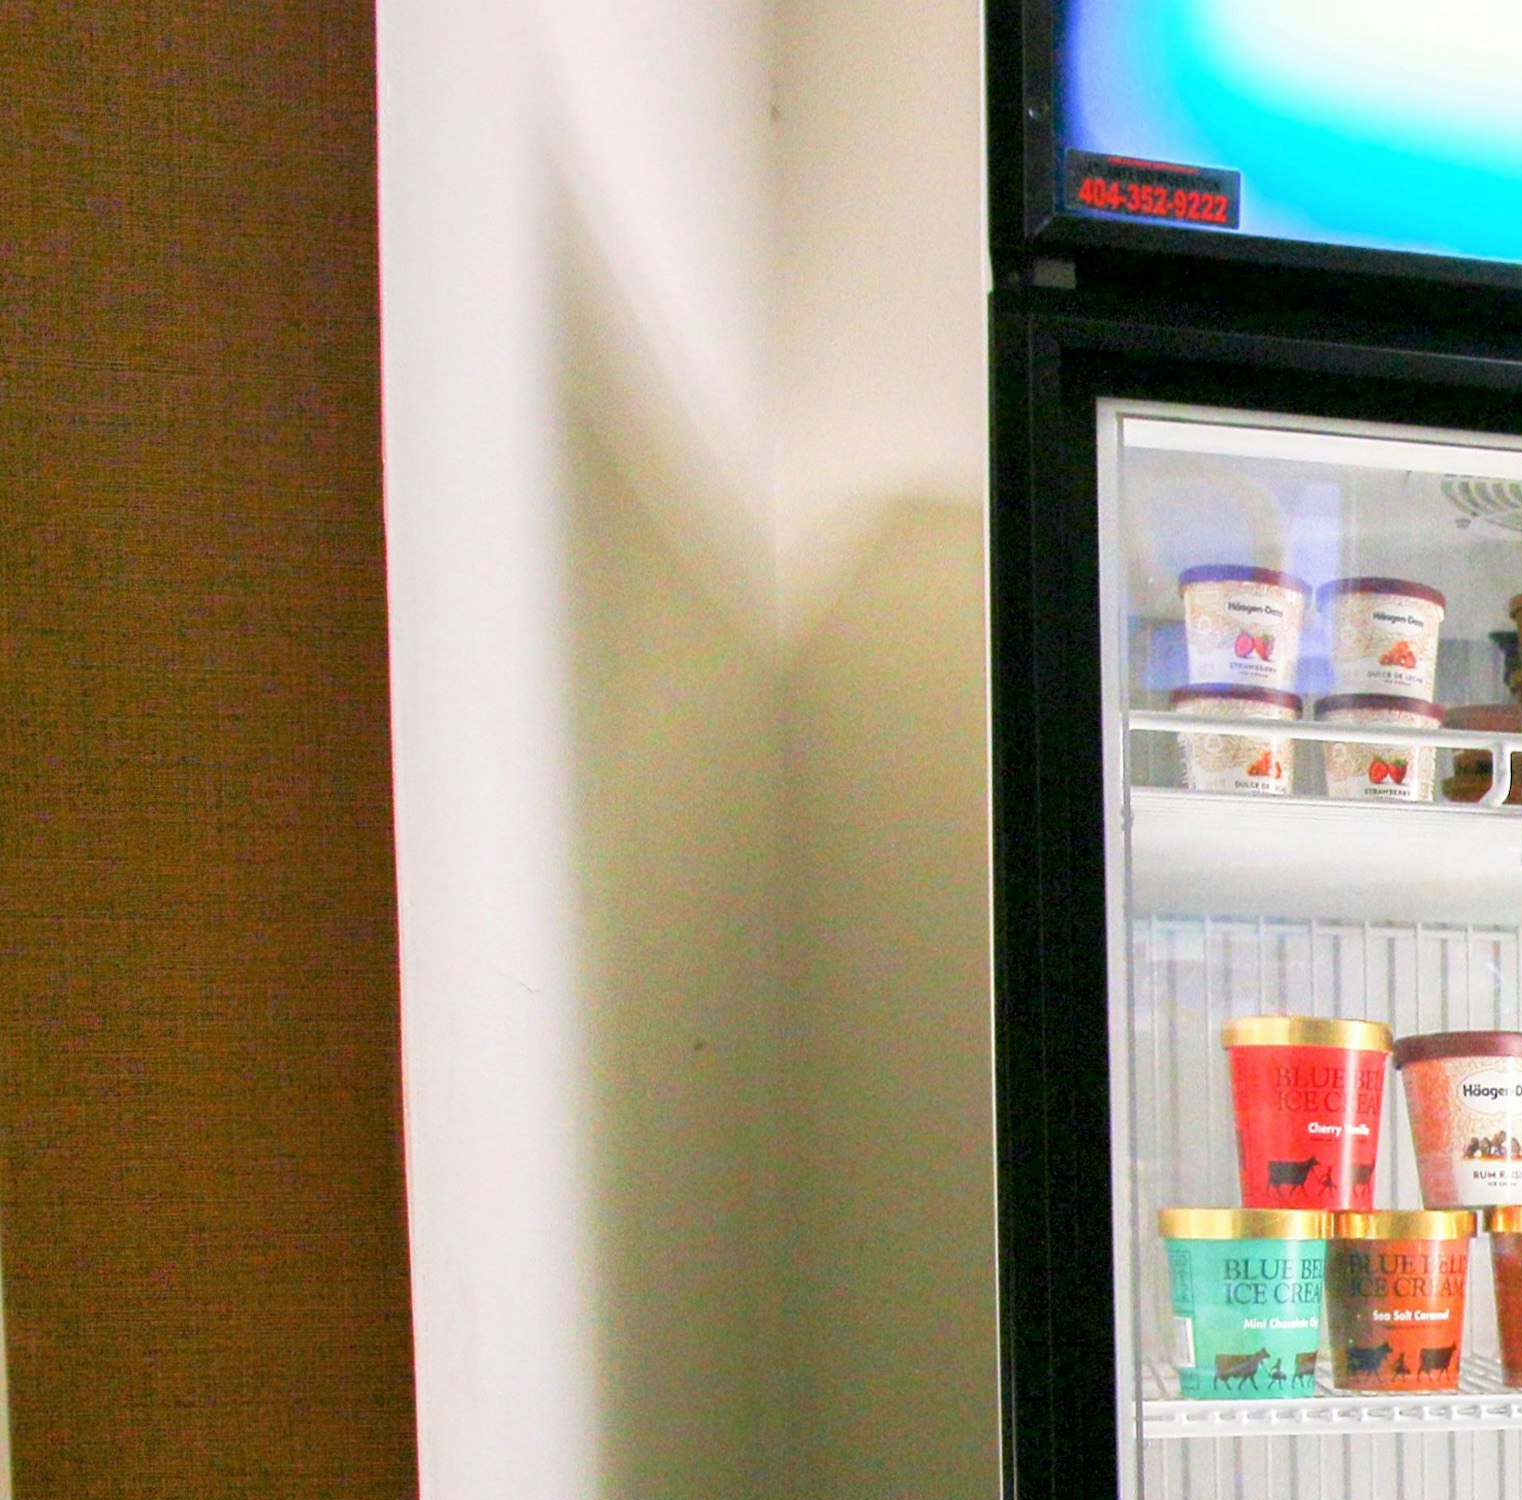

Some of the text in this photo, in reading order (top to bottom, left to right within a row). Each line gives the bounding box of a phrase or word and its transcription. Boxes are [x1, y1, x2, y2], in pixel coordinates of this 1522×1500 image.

[1079, 177, 1228, 225] 404-352-9222
[1275, 1064, 1344, 1089] BLUE
[1277, 1090, 1318, 1112] ICE
[1307, 1121, 1343, 1137] Cherry
[1473, 1170, 1496, 1179] RUM
[1222, 1258, 1294, 1280] BLUE
[1345, 1252, 1419, 1275] BLUE
[1224, 1283, 1267, 1305] ICE
[1243, 1319, 1266, 1330] Mint
[1373, 1309, 1450, 1321] Sea Salt Caramel
